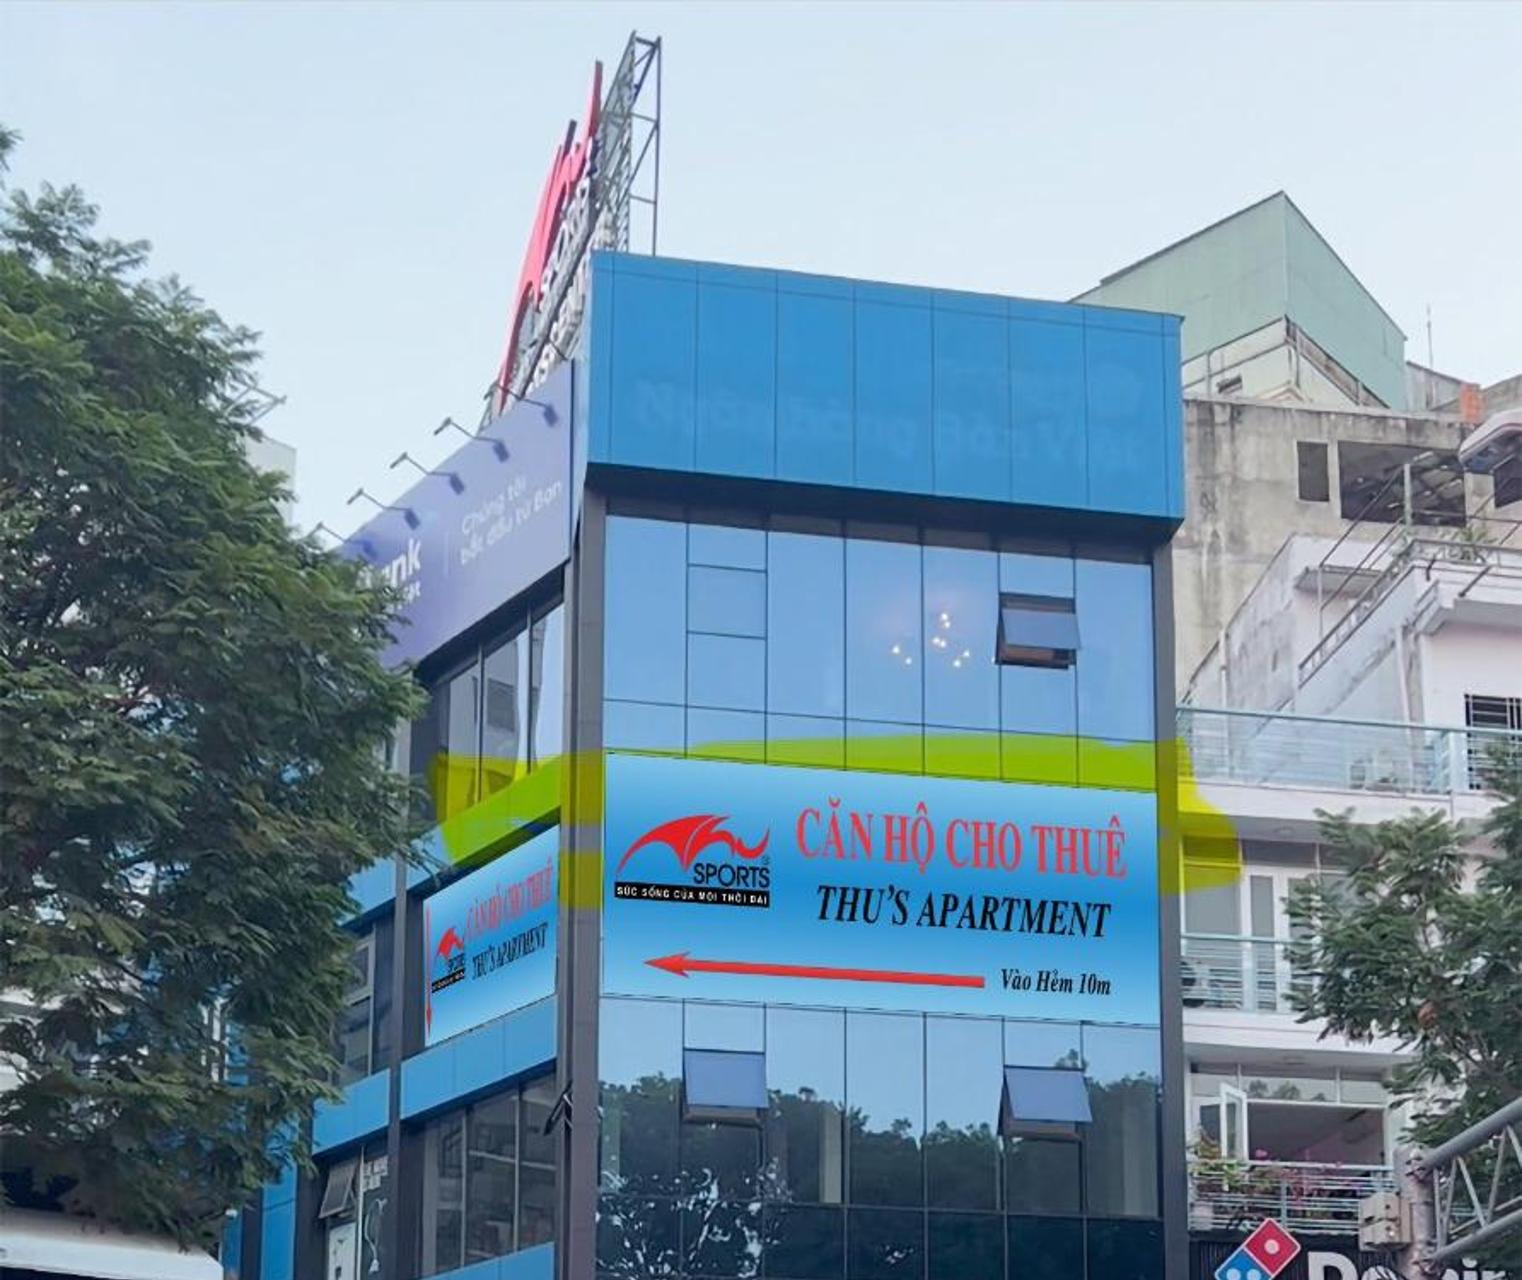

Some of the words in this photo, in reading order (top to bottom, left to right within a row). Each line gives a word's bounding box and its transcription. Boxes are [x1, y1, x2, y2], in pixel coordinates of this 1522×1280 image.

[796, 795, 873, 860] CĂN
[883, 801, 935, 874] HỘ
[945, 819, 1021, 872] CHO
[1031, 815, 1127, 879] THUÊ
[693, 862, 770, 888] SPORTS
[916, 892, 1111, 938] APARTMENT
[1000, 968, 1031, 991] Vào
[1078, 973, 1111, 995] 10m
